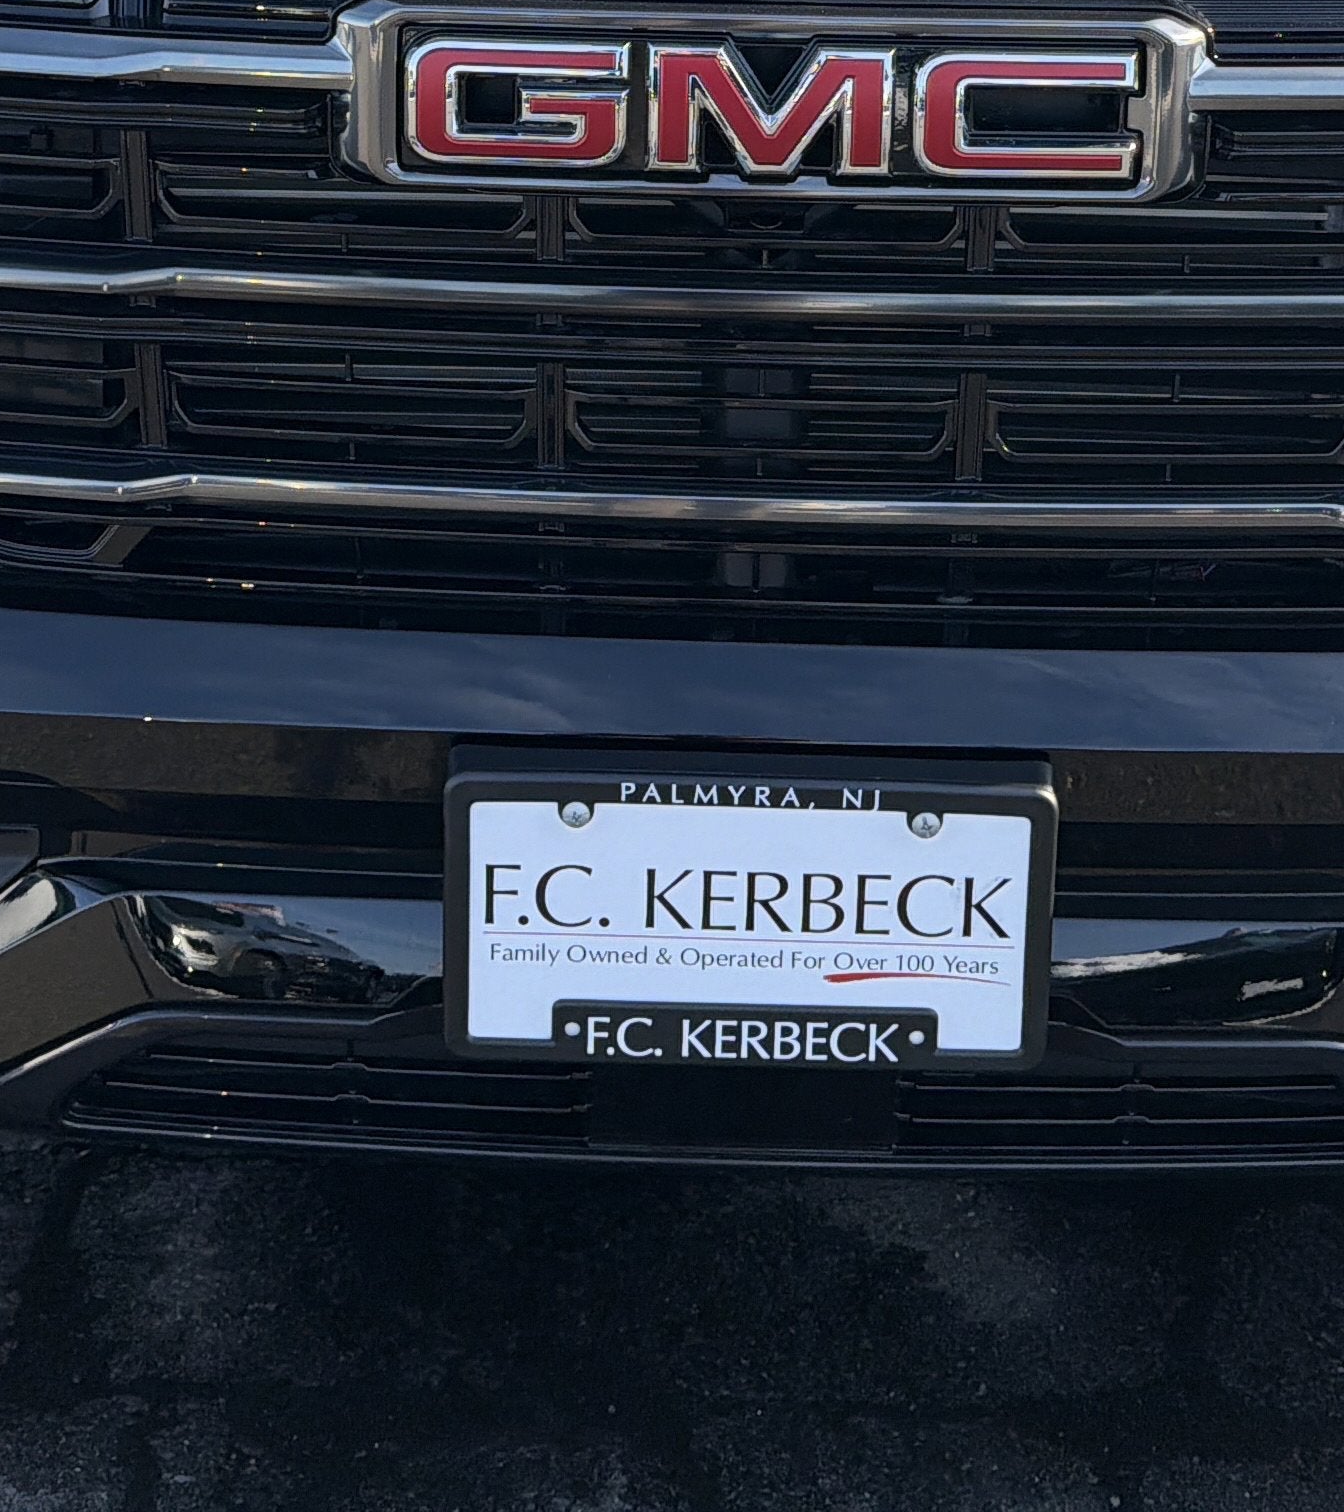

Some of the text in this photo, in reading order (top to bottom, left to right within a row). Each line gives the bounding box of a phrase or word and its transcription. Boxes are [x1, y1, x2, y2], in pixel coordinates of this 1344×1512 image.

[405, 38, 1141, 176] GMC
[620, 782, 881, 812] PALMYRA, NJ
[484, 864, 1012, 939] F.C. KERBECK
[490, 943, 999, 975] Family Owned & Operated For Over 100 Years
[586, 1016, 899, 1063] F.C. KERBECK
